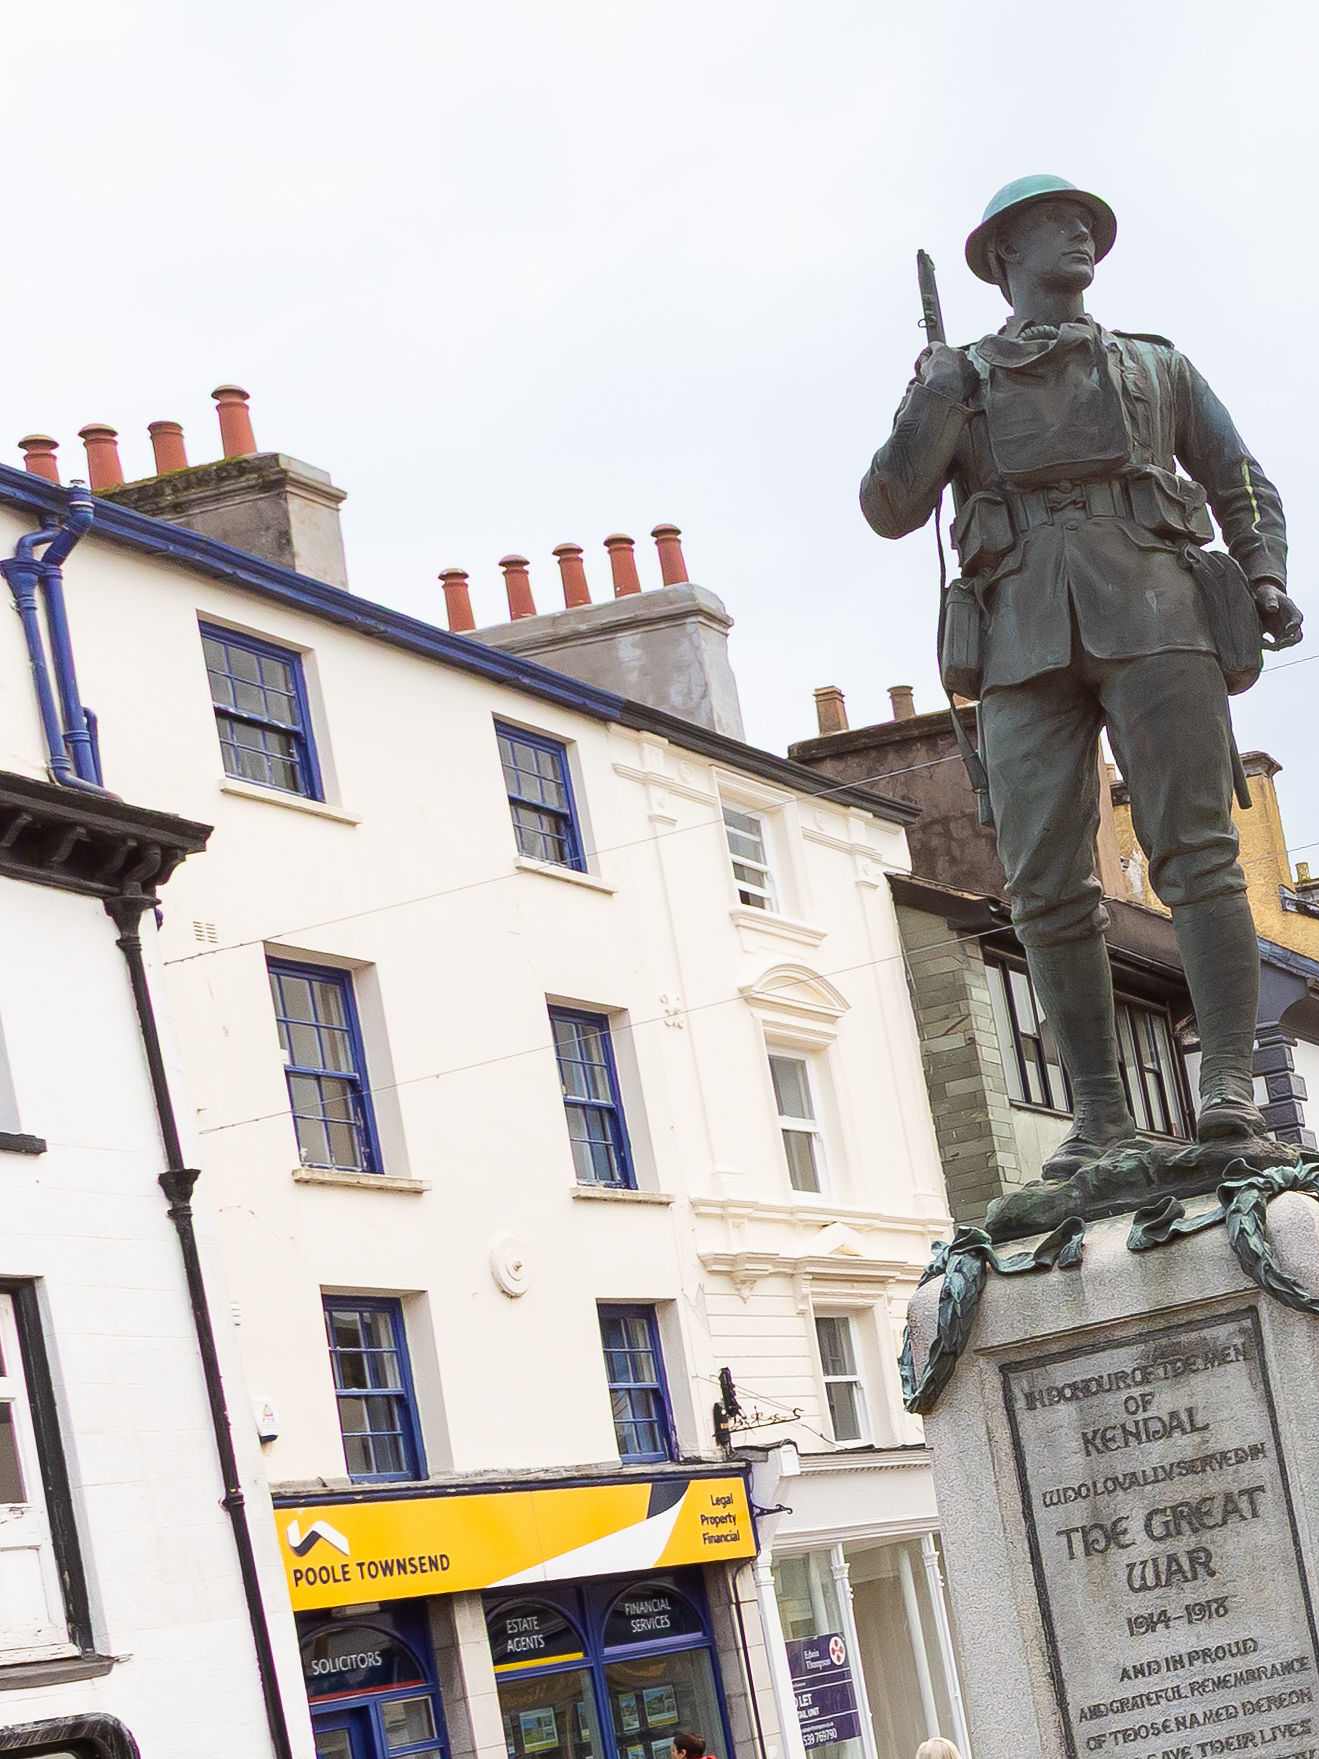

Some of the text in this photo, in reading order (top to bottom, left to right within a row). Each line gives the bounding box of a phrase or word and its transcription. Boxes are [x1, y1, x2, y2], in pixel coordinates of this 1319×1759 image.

[1124, 1391, 1155, 1416] OF
[1081, 1405, 1210, 1457] KENDAL
[1042, 1483, 1092, 1509] WHO
[1094, 1463, 1176, 1496] LOYALLY
[1177, 1446, 1250, 1477] SERVED
[710, 1492, 734, 1509] Legal
[700, 1512, 737, 1527] Property
[1055, 1485, 1265, 1561] THE GREAT
[702, 1530, 740, 1545] Financial
[293, 1554, 450, 1588] POOLE TOWNSEND
[1126, 1546, 1217, 1594] WAR
[624, 1598, 672, 1617] FINANCIAL
[506, 1616, 540, 1634] ESTATE
[631, 1615, 671, 1634] SERVICES
[507, 1634, 545, 1653] AGENTS
[312, 1651, 383, 1676] SOLICITORS
[1119, 1638, 1258, 1682] AND IN PROUD
[1110, 1685, 1190, 1715] GRATEFUL
[1189, 1656, 1313, 1698] REMEMBRANCE
[1085, 1734, 1107, 1753] OF
[1109, 1719, 1175, 1746] THOSE
[1174, 1704, 1240, 1732] NAMED
[1197, 1730, 1258, 1759] THEIR
[1259, 1719, 1313, 1744] LIVES
